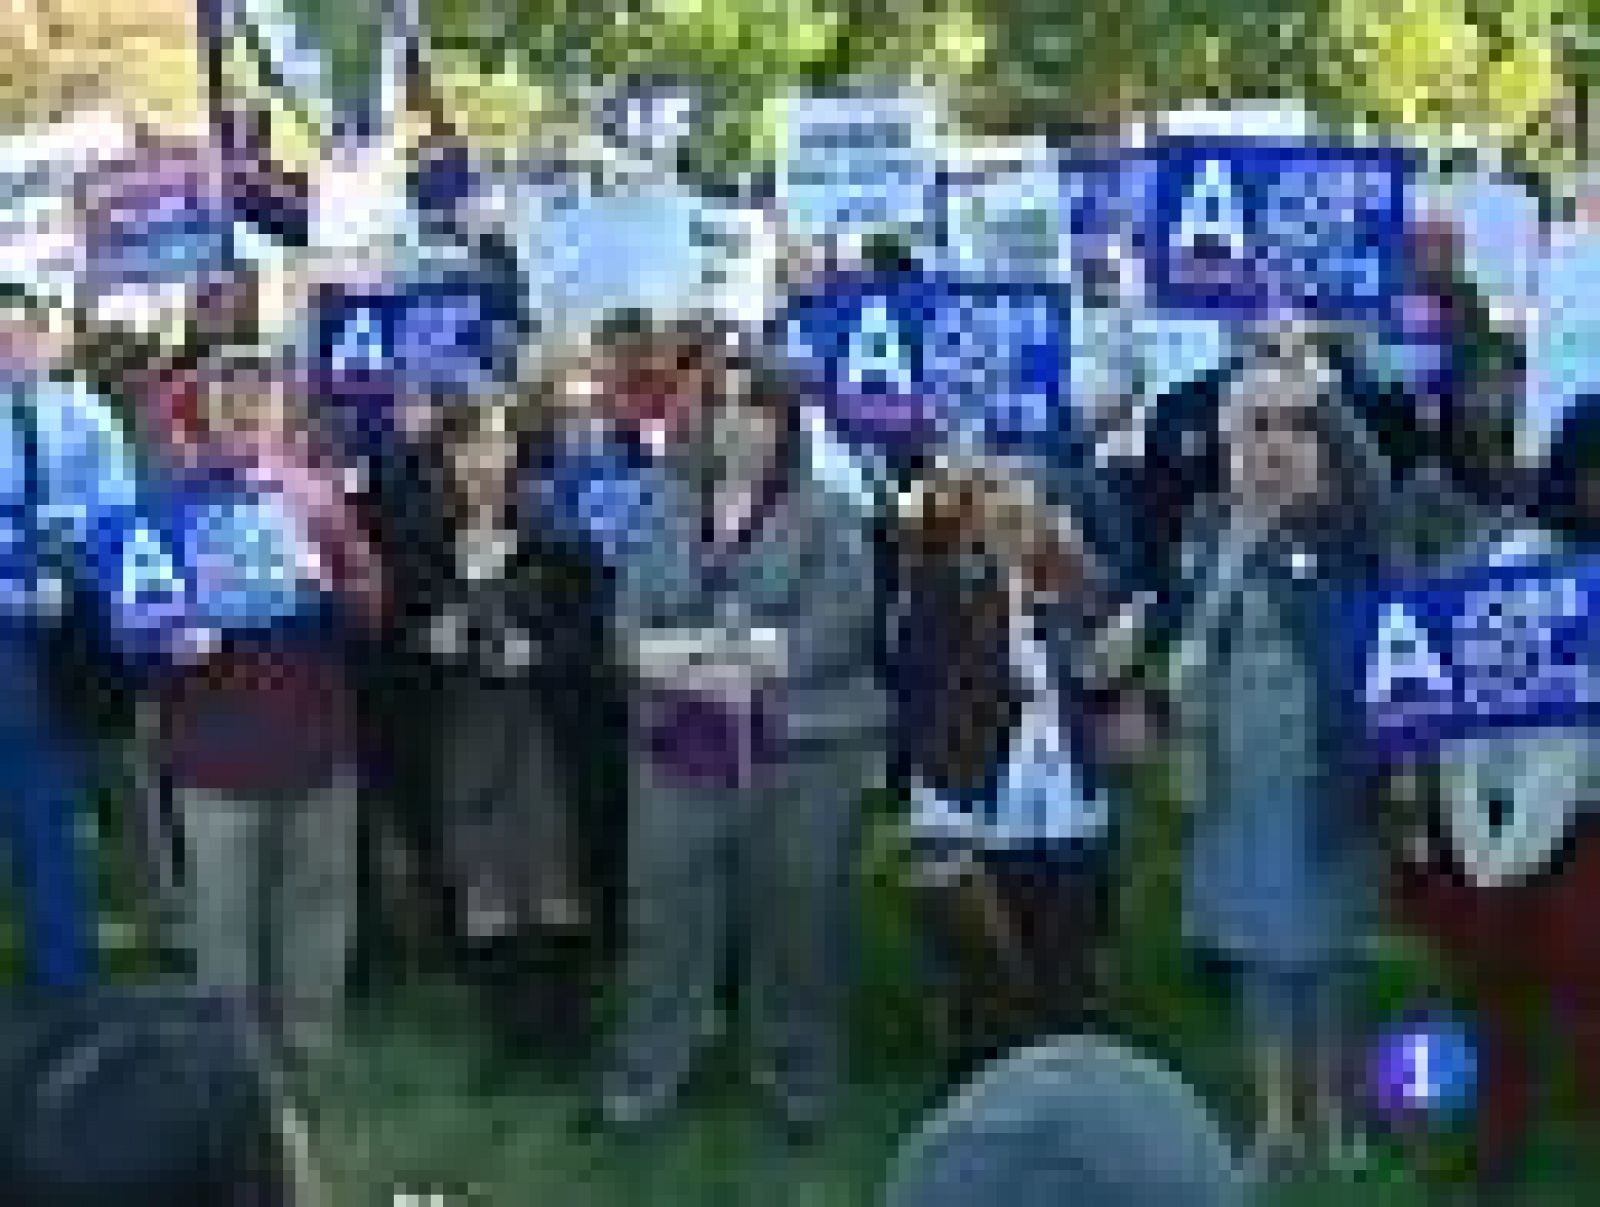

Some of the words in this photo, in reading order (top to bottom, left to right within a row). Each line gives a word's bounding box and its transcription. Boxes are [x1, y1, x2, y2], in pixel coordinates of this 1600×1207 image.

[1168, 160, 1243, 258] A
[836, 296, 911, 394] A
[122, 527, 185, 603] A
[1366, 603, 1452, 702] A
